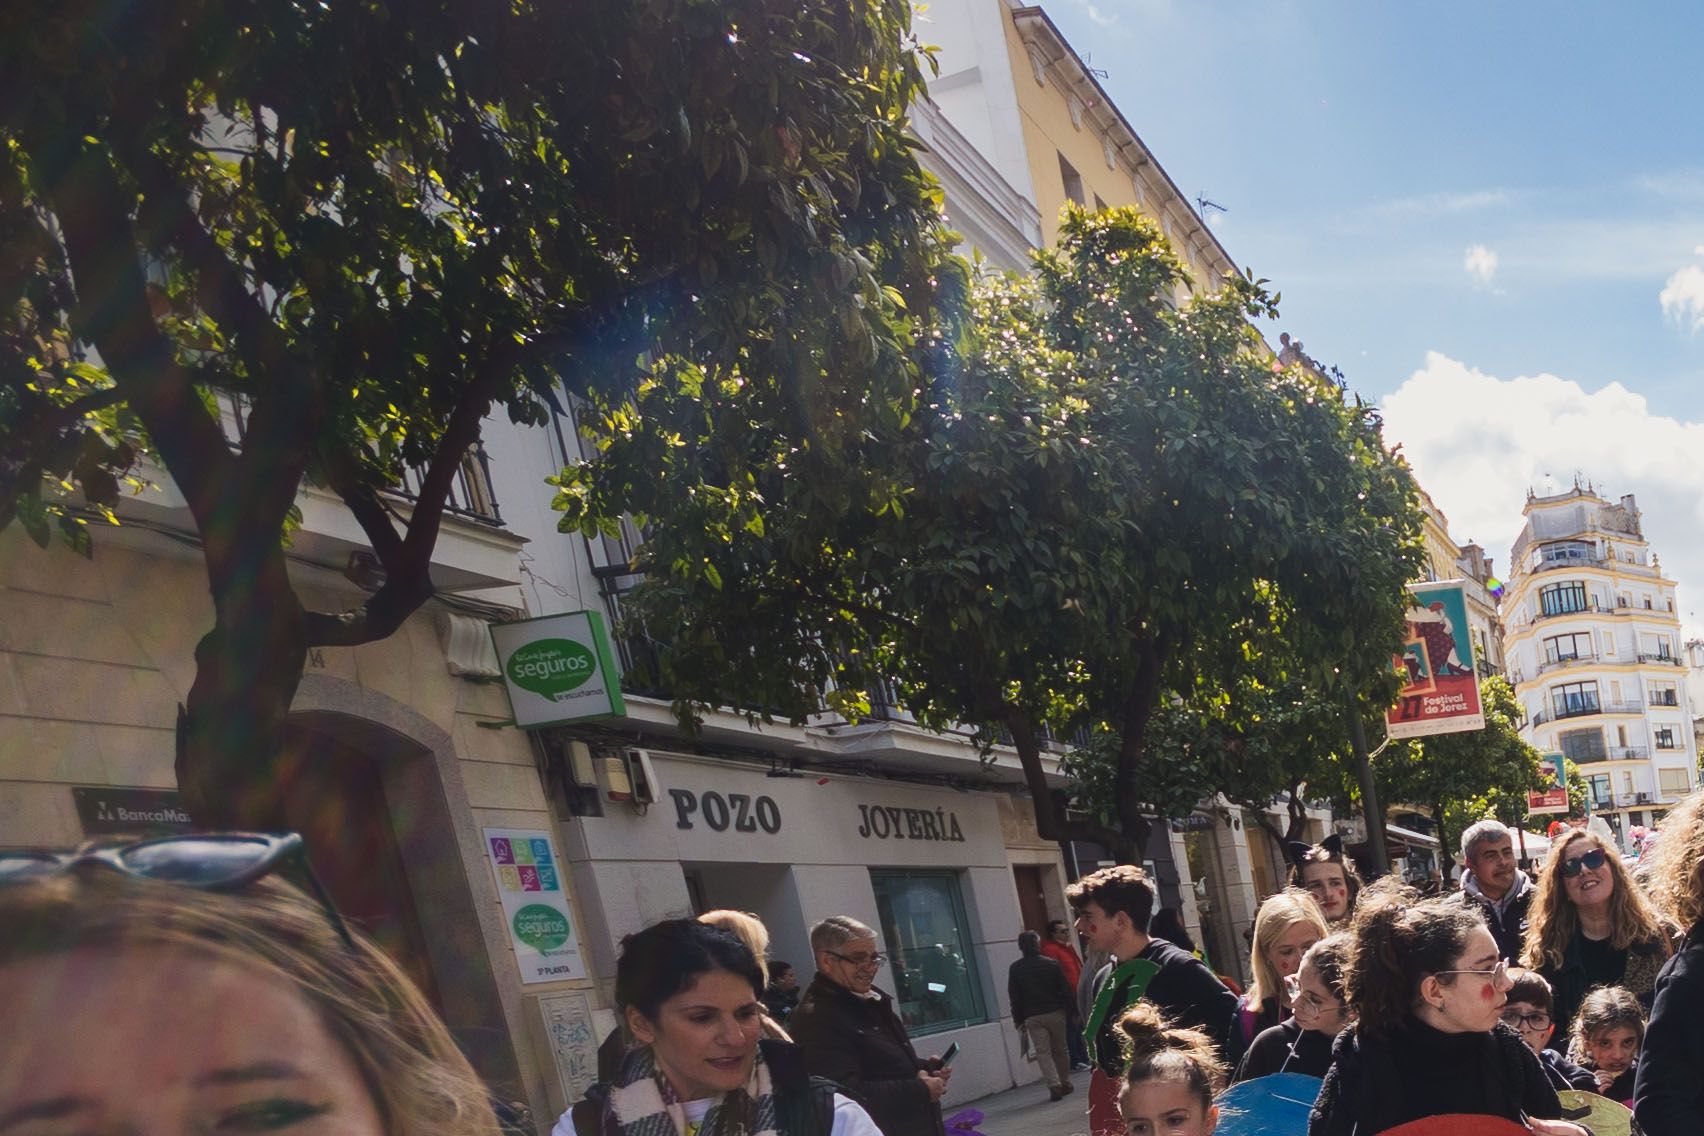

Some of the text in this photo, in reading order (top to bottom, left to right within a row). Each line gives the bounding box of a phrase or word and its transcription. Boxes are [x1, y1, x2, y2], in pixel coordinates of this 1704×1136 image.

[514, 654, 588, 680] seguros
[1423, 693, 1463, 706] Festival
[1424, 702, 1468, 714] de Jerez
[668, 788, 966, 842] POZO JOYERÍA
[518, 920, 566, 938] seguros
[544, 965, 570, 976] PLANTA
